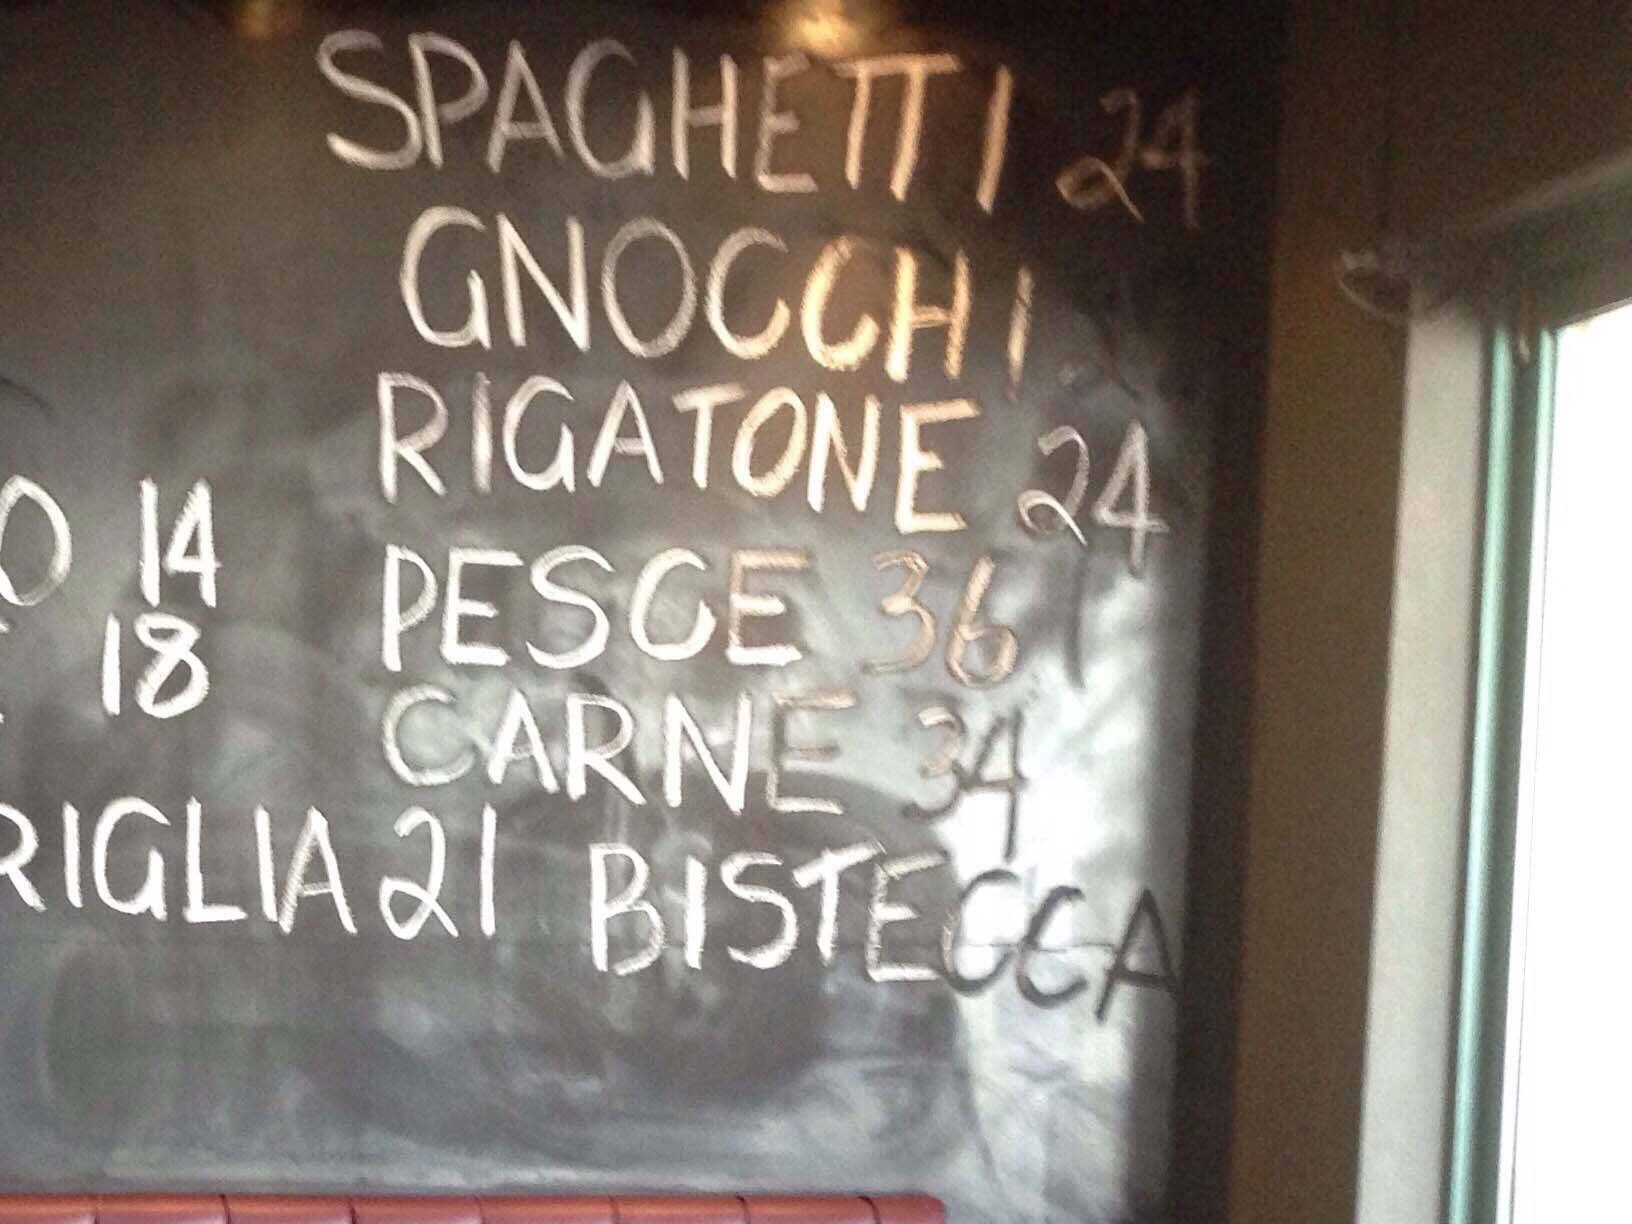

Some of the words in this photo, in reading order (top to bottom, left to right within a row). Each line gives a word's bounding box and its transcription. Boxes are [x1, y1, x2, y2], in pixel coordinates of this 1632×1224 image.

[316, 28, 1014, 214] SPAGHETTI
[1055, 88, 1210, 230] 24
[398, 204, 1035, 399] GNOCCHI
[138, 476, 220, 608] 14
[376, 370, 982, 537] RIGATONE
[1016, 419, 1170, 577] 24
[102, 609, 210, 719] 18
[381, 544, 811, 673] PESCE
[863, 550, 1019, 690] 36
[381, 681, 856, 817] CARNE
[901, 705, 1030, 862] 34
[377, 802, 496, 941] 21
[588, 836, 1182, 1024] BISTECCA
